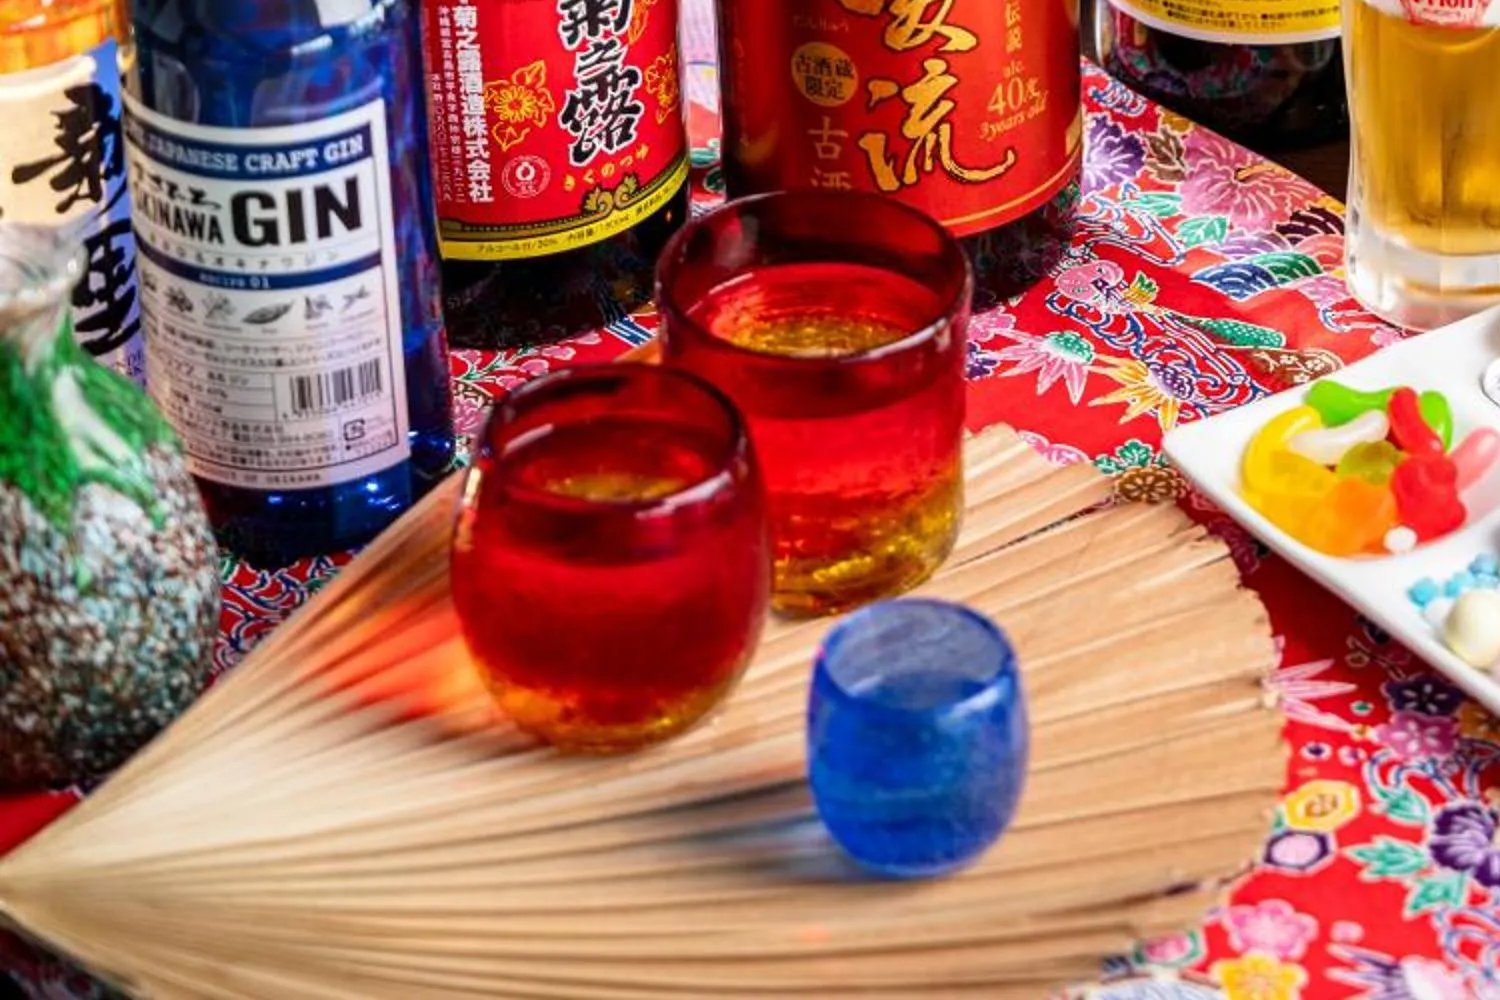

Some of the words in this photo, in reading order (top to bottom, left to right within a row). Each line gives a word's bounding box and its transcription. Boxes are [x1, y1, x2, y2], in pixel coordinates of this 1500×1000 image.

[244, 147, 319, 174] CRAFT
[323, 133, 364, 163] GIN
[229, 173, 364, 248] GIN
